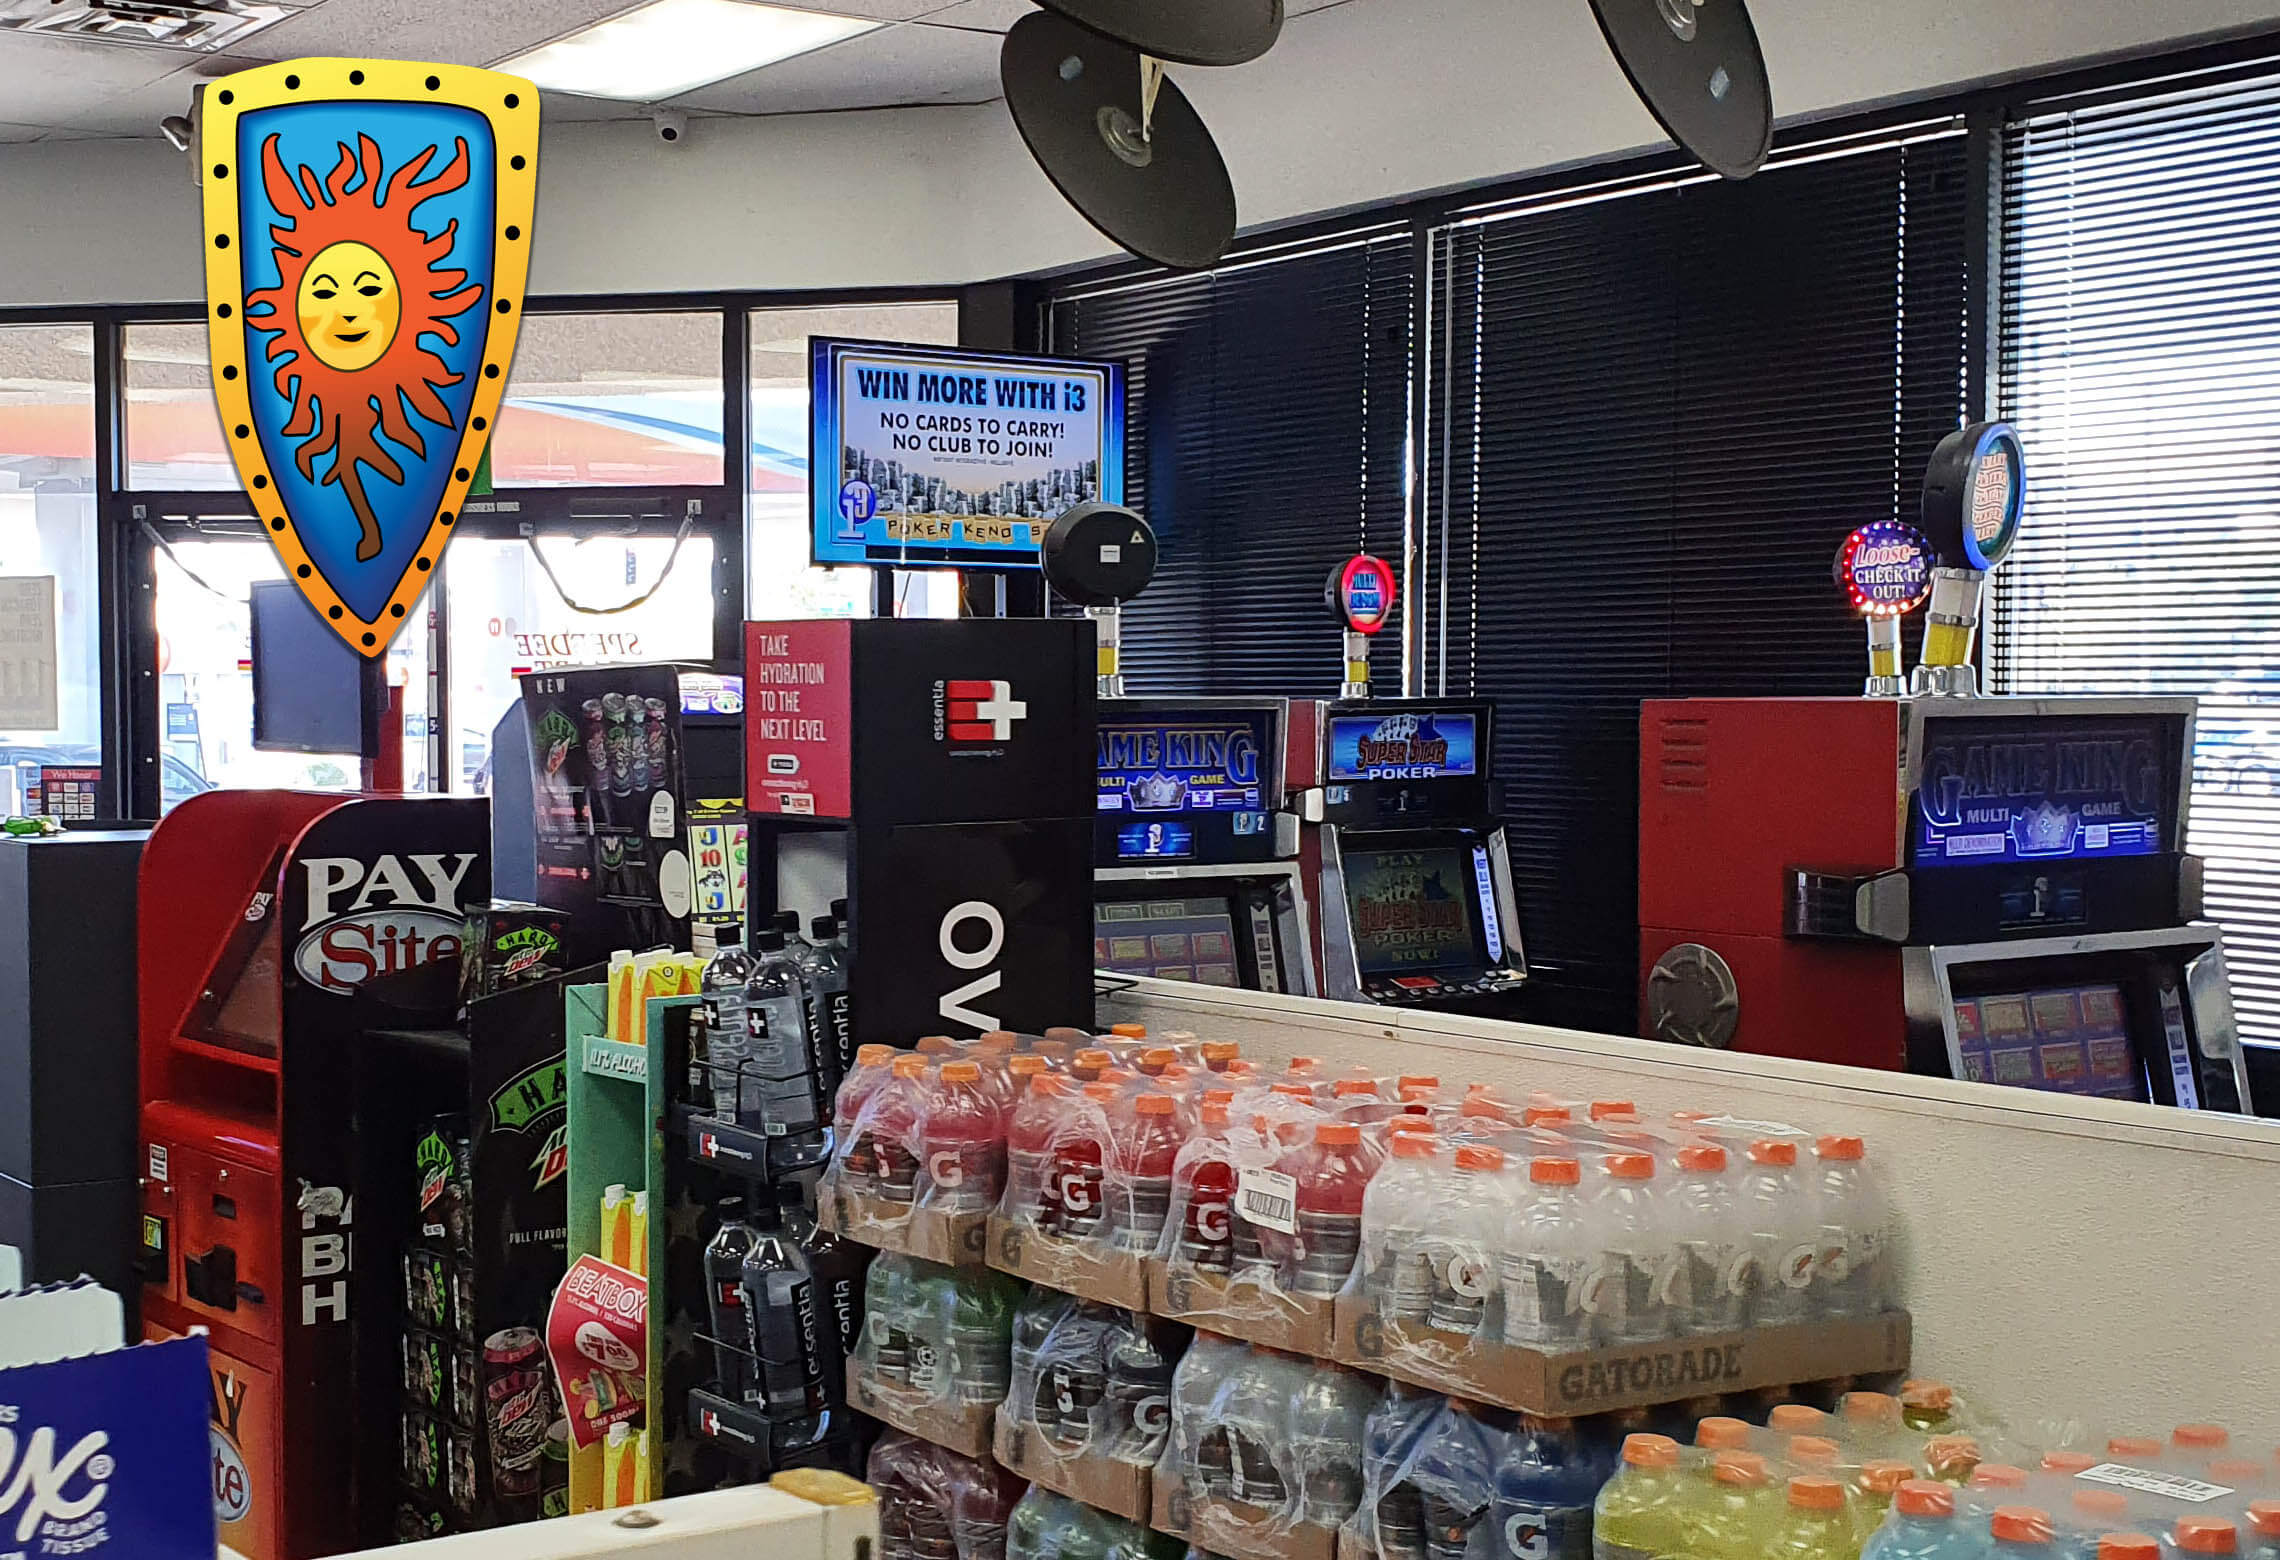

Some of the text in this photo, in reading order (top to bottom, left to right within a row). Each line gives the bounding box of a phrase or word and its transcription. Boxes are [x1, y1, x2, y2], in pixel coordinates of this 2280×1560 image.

[857, 368, 1087, 412] WIN MORE WITH i3
[880, 412, 1065, 439] NO CARDS TO CARRY!
[893, 434, 1053, 458] NO CLUB TO JOIN!
[964, 523, 1011, 539] KENO
[1855, 569, 1921, 584] CHECK IT
[1873, 585, 1907, 599] OUT!
[760, 635, 789, 656] TAKE
[760, 663, 825, 684] HYDRATION
[760, 690, 801, 712] TO THE
[932, 679, 945, 741] essentia
[760, 718, 827, 742] NEXT LEVEL
[1097, 729, 1259, 785] AME KING
[1357, 732, 1449, 769] SUPER STAR
[1099, 776, 1126, 788] ULTI
[1189, 774, 1225, 785] GAME
[1368, 767, 1437, 780] POKER
[1921, 740, 2160, 828] GAME KING
[1967, 808, 2010, 824] MULTI
[2082, 802, 2122, 816] GAME
[300, 853, 478, 932] PAY
[321, 923, 462, 989] Site
[930, 1151, 963, 1187] G
[1061, 1174, 1090, 1211] G
[1197, 1202, 1229, 1240] G
[509, 1231, 531, 1244] FULL
[566, 1264, 648, 1324] BEATBOX
[798, 1284, 820, 1376] esentia
[1559, 1343, 1744, 1401] GATORADE
[214, 1447, 244, 1510] te
[42, 1511, 108, 1536] BRAND
[1505, 1512, 1549, 1560] G
[41, 1526, 111, 1556] TISSUE
